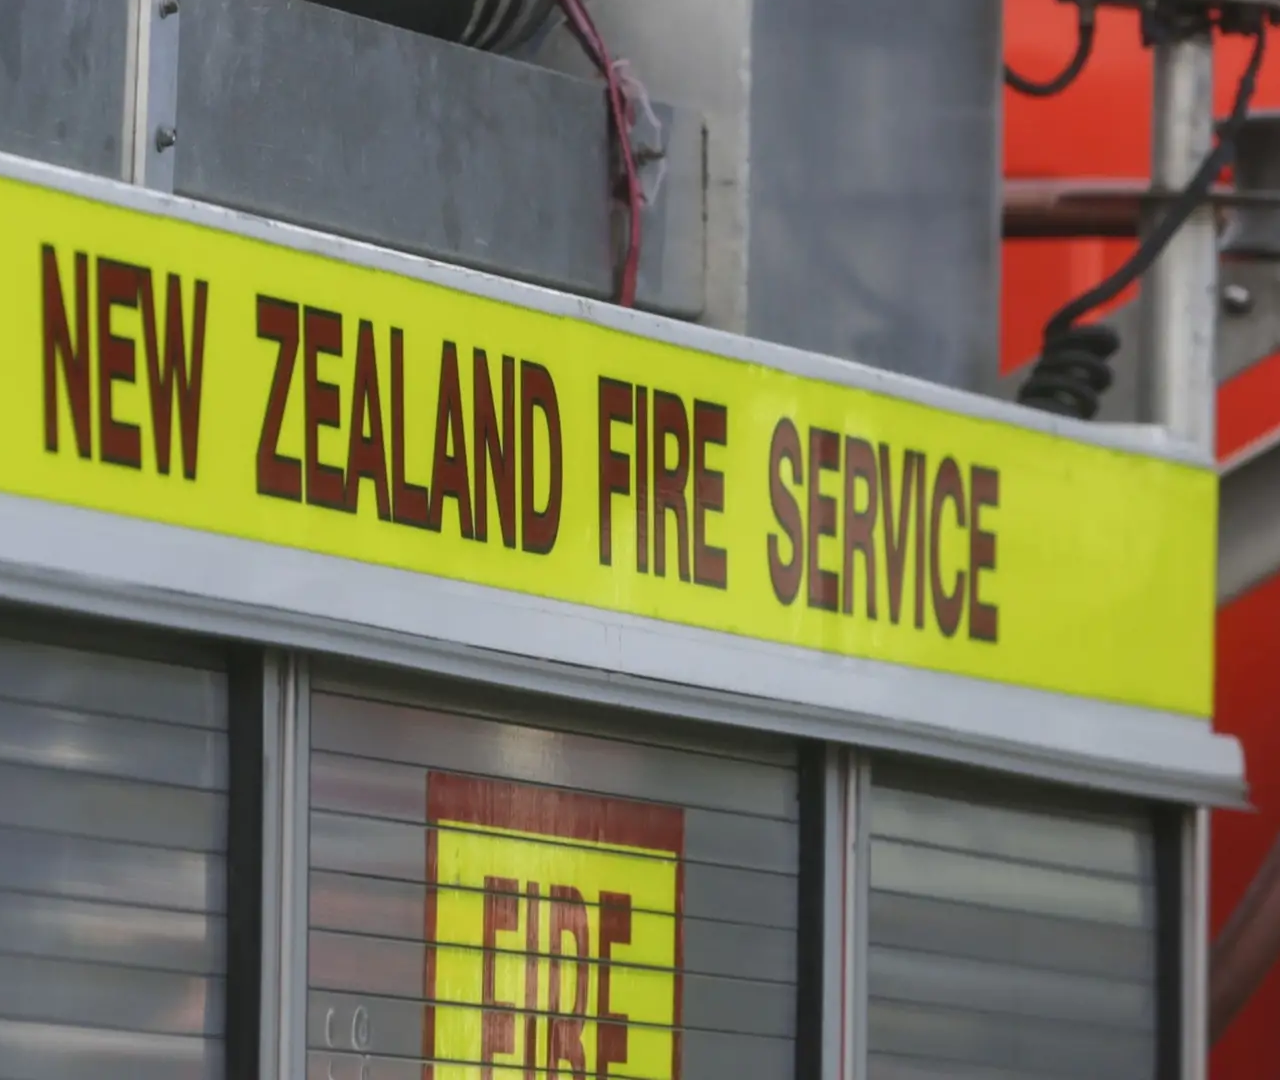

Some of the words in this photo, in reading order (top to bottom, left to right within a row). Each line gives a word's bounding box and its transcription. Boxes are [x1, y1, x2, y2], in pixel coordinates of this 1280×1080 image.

[40, 243, 209, 481] NEW
[255, 294, 563, 555] ZEALAND
[597, 375, 728, 590] FIRE
[767, 416, 999, 643] SERVICE
[480, 875, 632, 1080] FIRE
